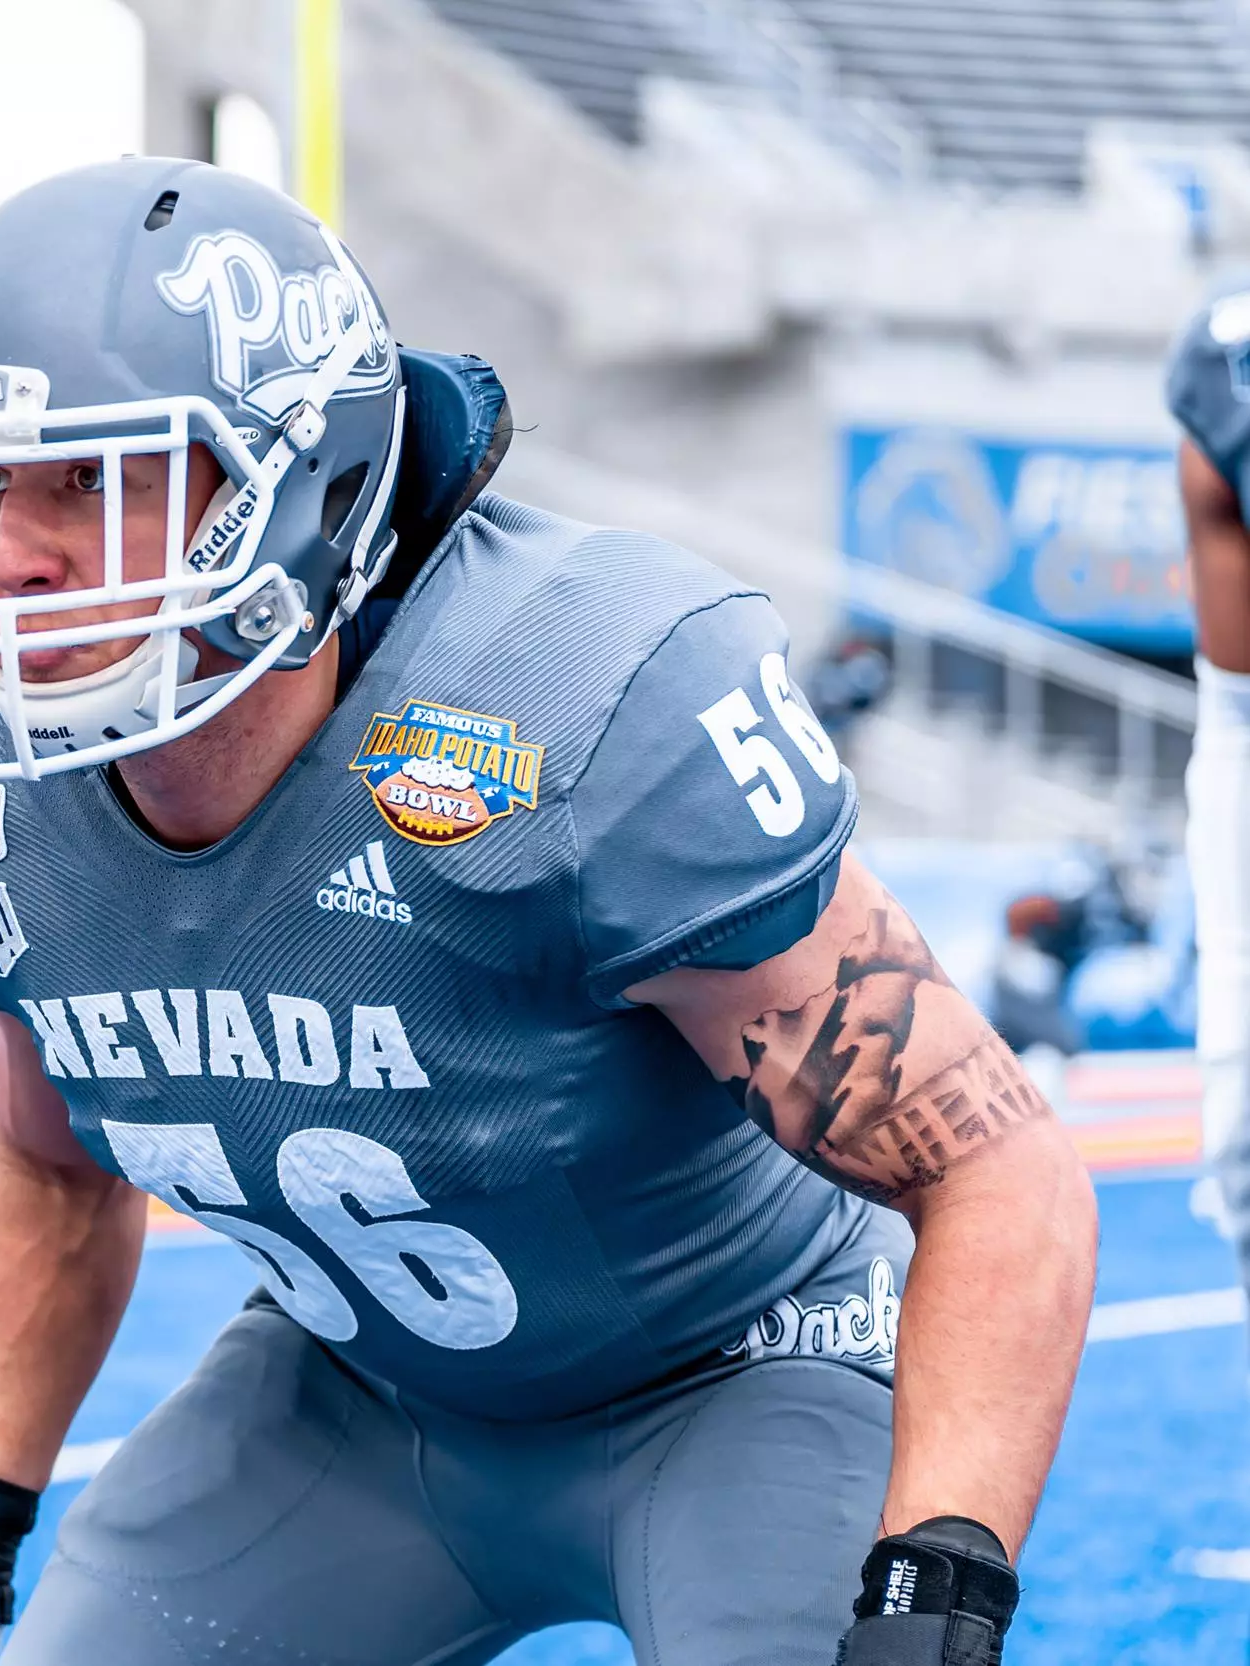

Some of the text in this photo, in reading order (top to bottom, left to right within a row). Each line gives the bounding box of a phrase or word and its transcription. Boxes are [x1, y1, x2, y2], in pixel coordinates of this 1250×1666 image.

[409, 707, 502, 739] FAMOUS
[696, 652, 841, 837] 56
[364, 722, 535, 793] IDAHO POTATO
[386, 783, 478, 822] BOWL
[316, 885, 413, 924] adidas
[18, 988, 431, 1089] NEVADA
[101, 1119, 518, 1350] 56
[895, 1564, 918, 1614] HOPEDICS
